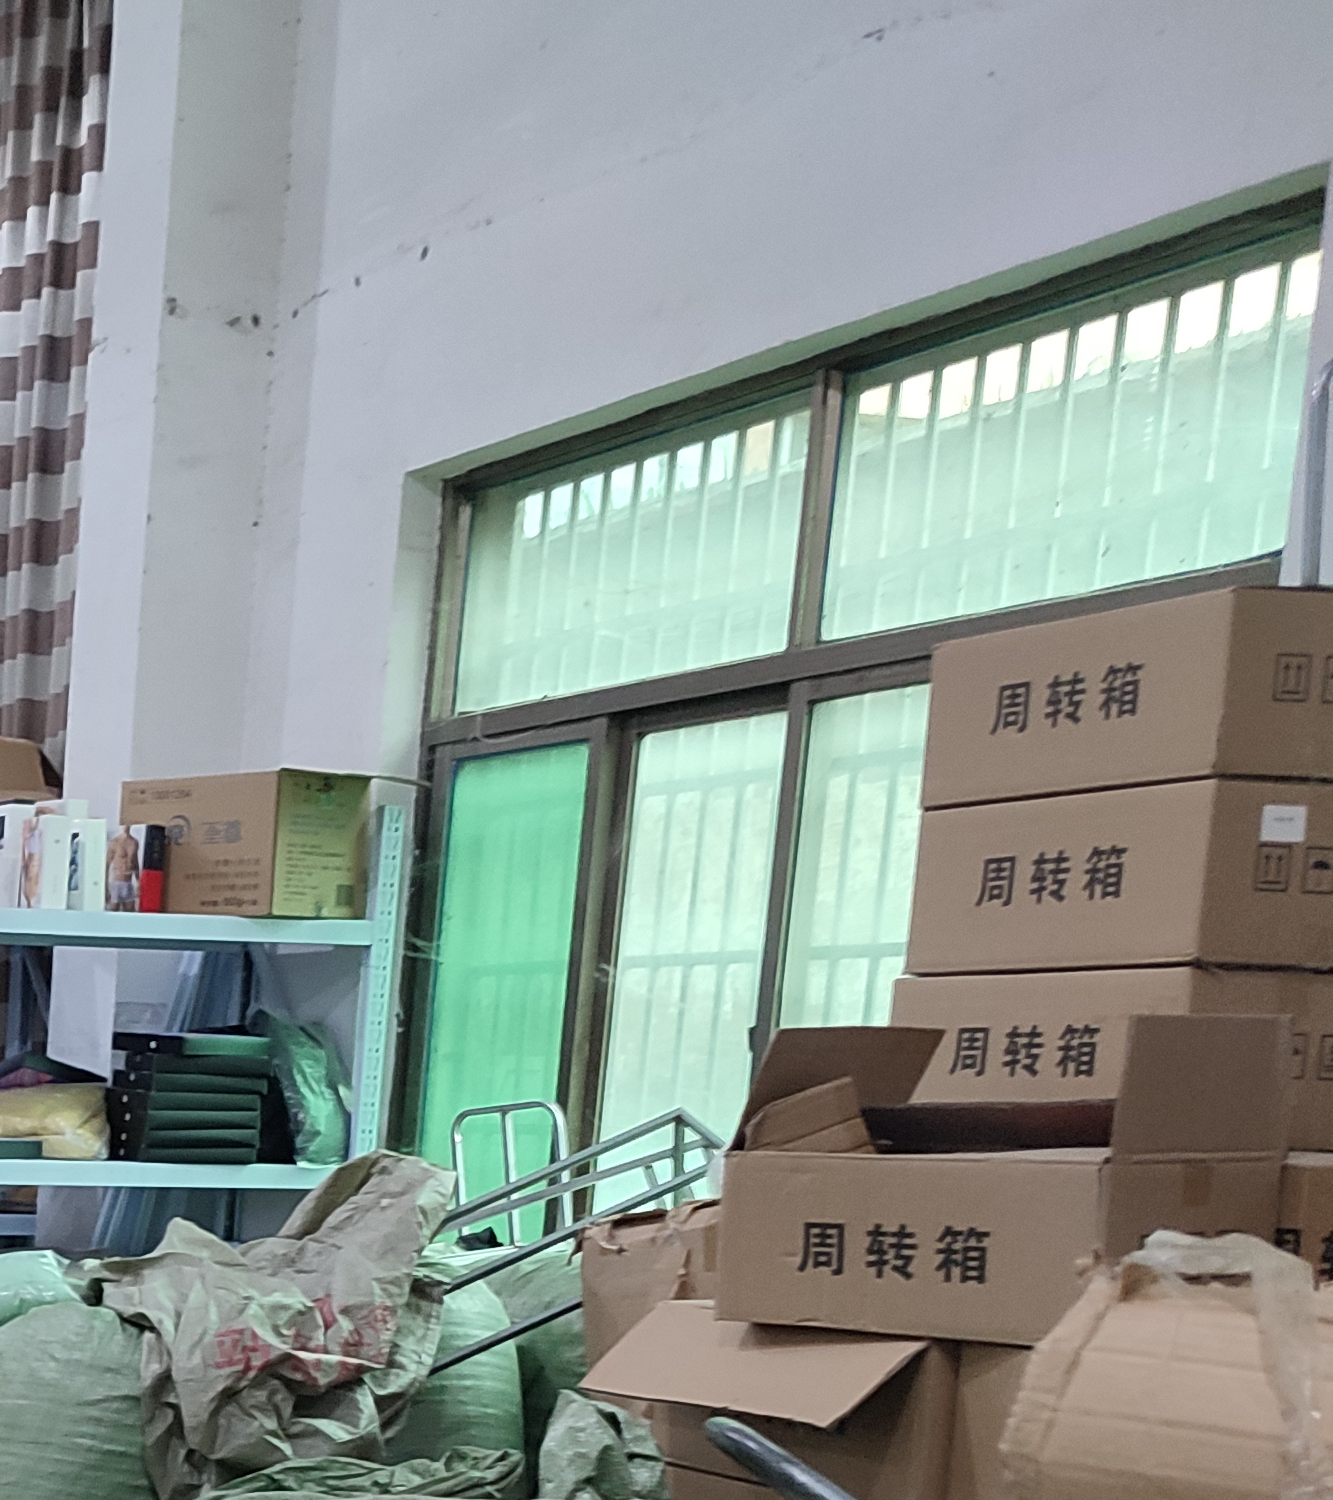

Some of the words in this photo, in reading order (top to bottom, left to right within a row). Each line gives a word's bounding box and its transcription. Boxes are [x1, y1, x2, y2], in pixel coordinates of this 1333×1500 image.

[989, 662, 1145, 735] 周转箱
[974, 844, 1129, 907] 周转箱
[949, 1023, 1101, 1078] 周转箱
[797, 1221, 991, 1285] 周转箱
